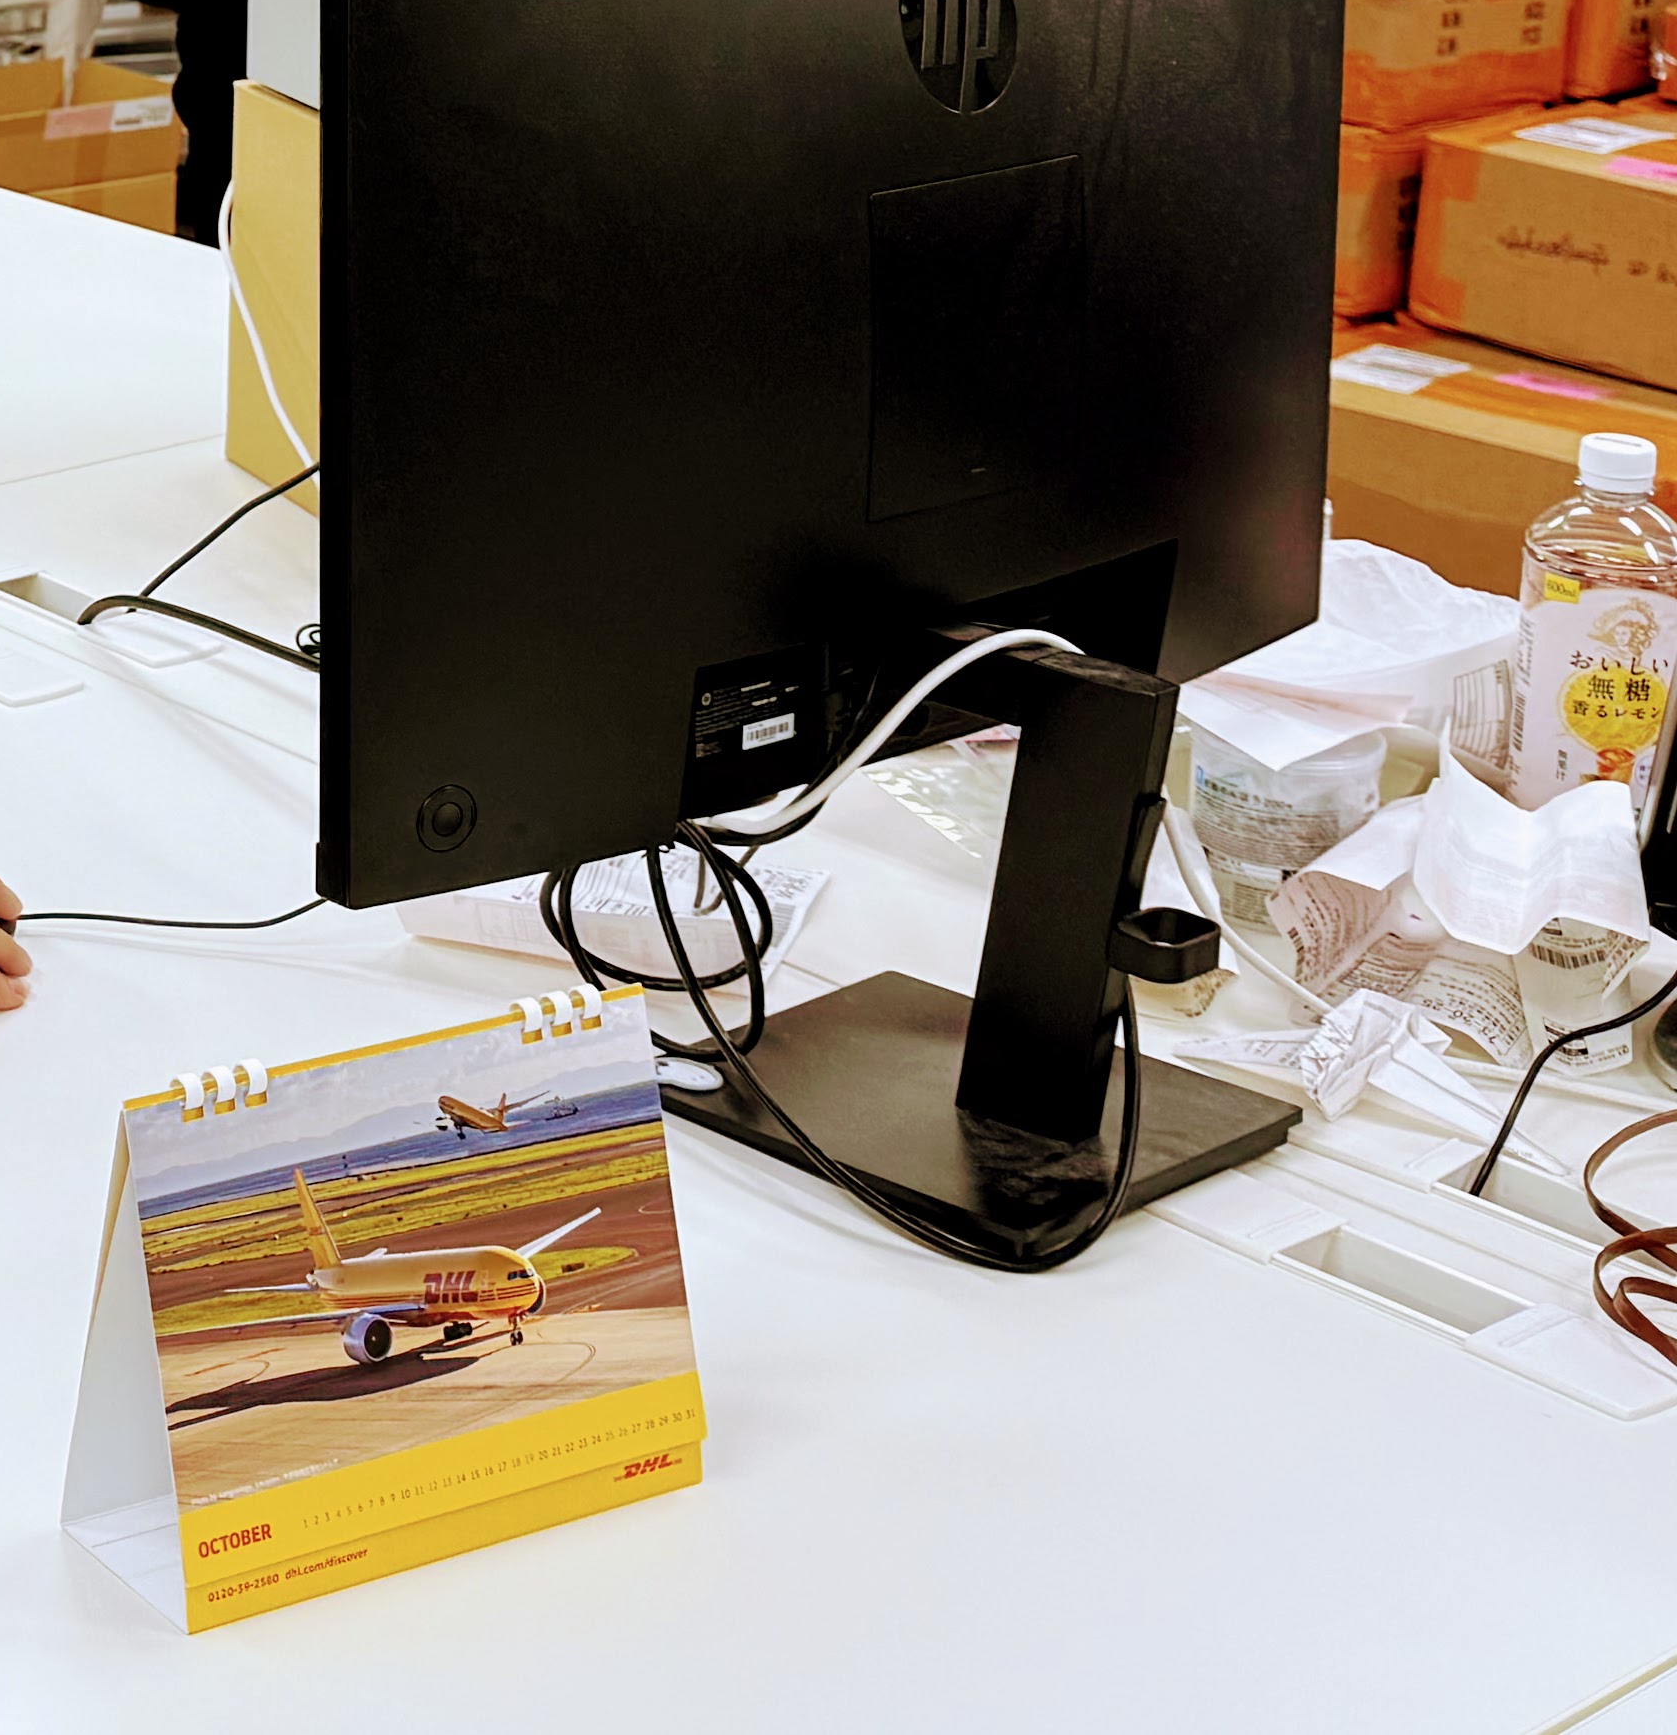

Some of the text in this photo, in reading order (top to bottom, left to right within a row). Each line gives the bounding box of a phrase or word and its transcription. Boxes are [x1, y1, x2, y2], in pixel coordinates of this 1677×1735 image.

[1570, 650, 1668, 676] おいしい
[1587, 675, 1650, 702] 無糖
[1572, 699, 1661, 720] 香るレモン
[424, 1270, 479, 1304] DHL
[624, 1454, 672, 1479] DHL
[198, 1524, 272, 1558] OCTOBER
